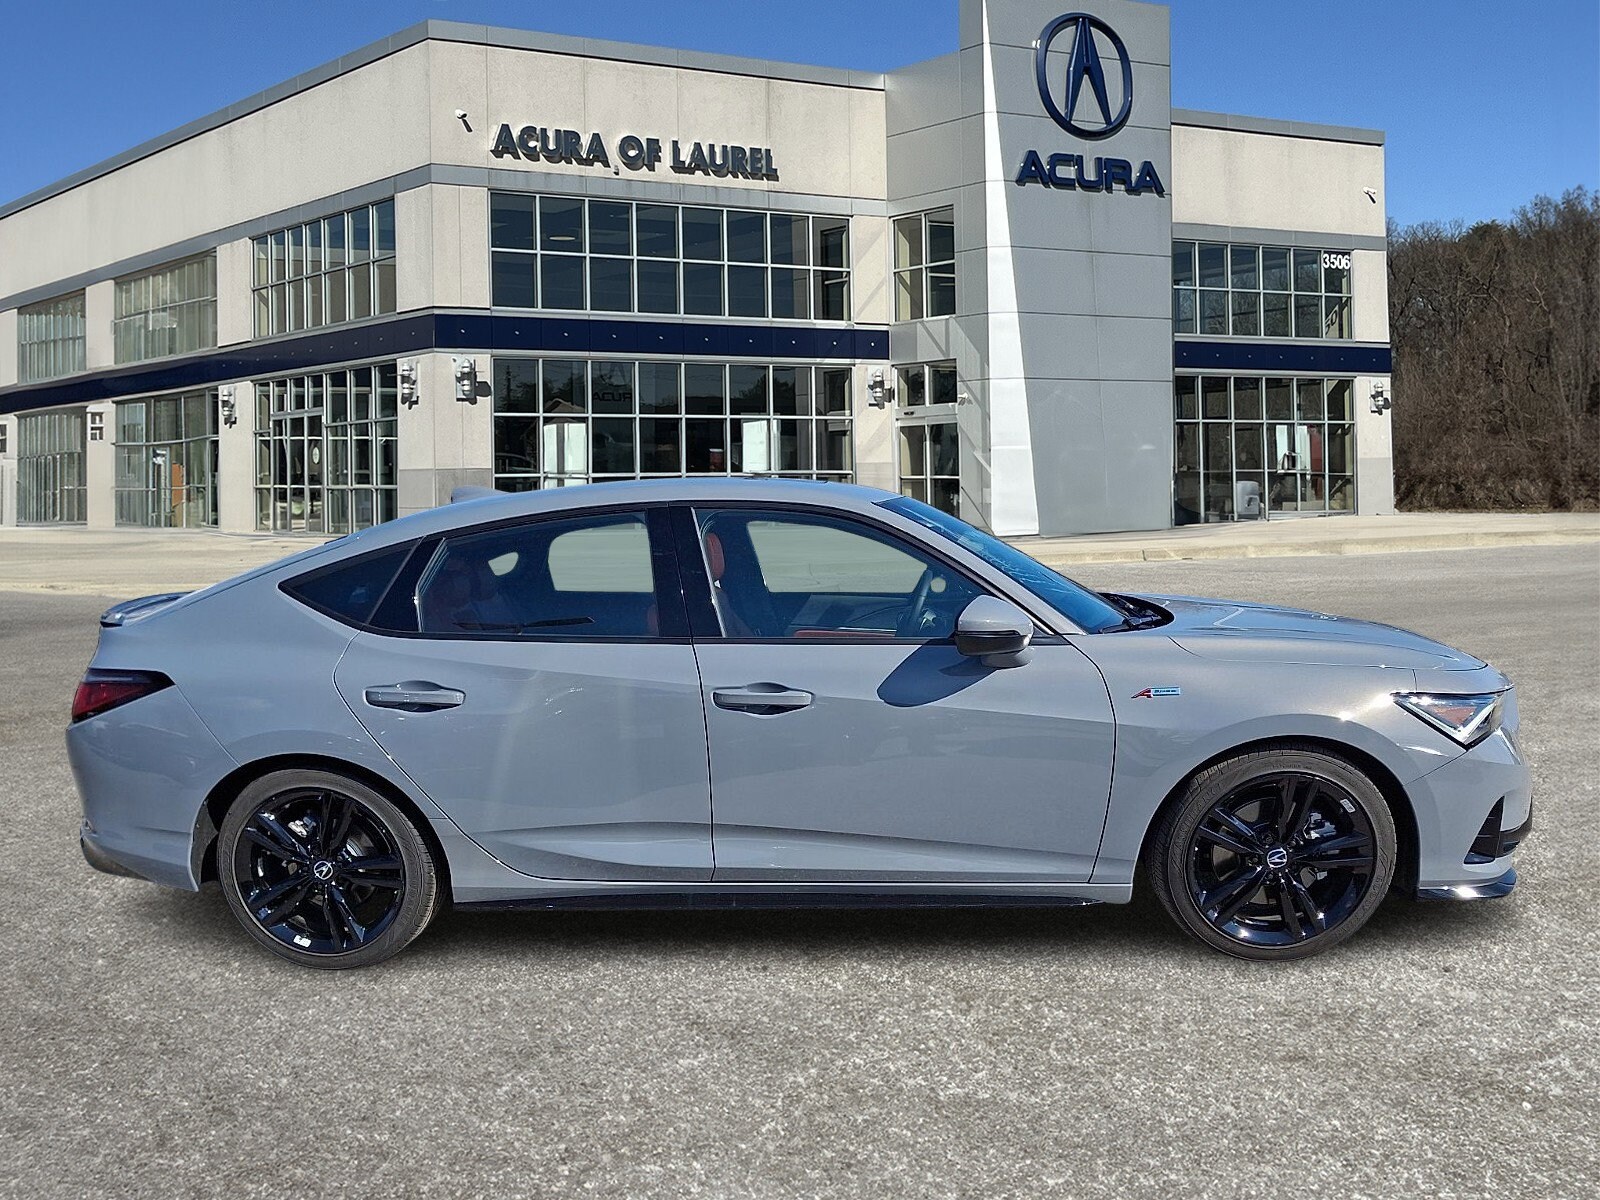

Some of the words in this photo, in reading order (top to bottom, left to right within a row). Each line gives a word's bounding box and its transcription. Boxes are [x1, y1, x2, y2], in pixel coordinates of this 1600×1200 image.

[491, 123, 609, 165] ACURA
[618, 135, 661, 168] OF
[670, 140, 779, 179] LAUREL
[1015, 150, 1165, 196] ACURA
[1322, 253, 1351, 269] 3506
[593, 391, 633, 402] ACUR
